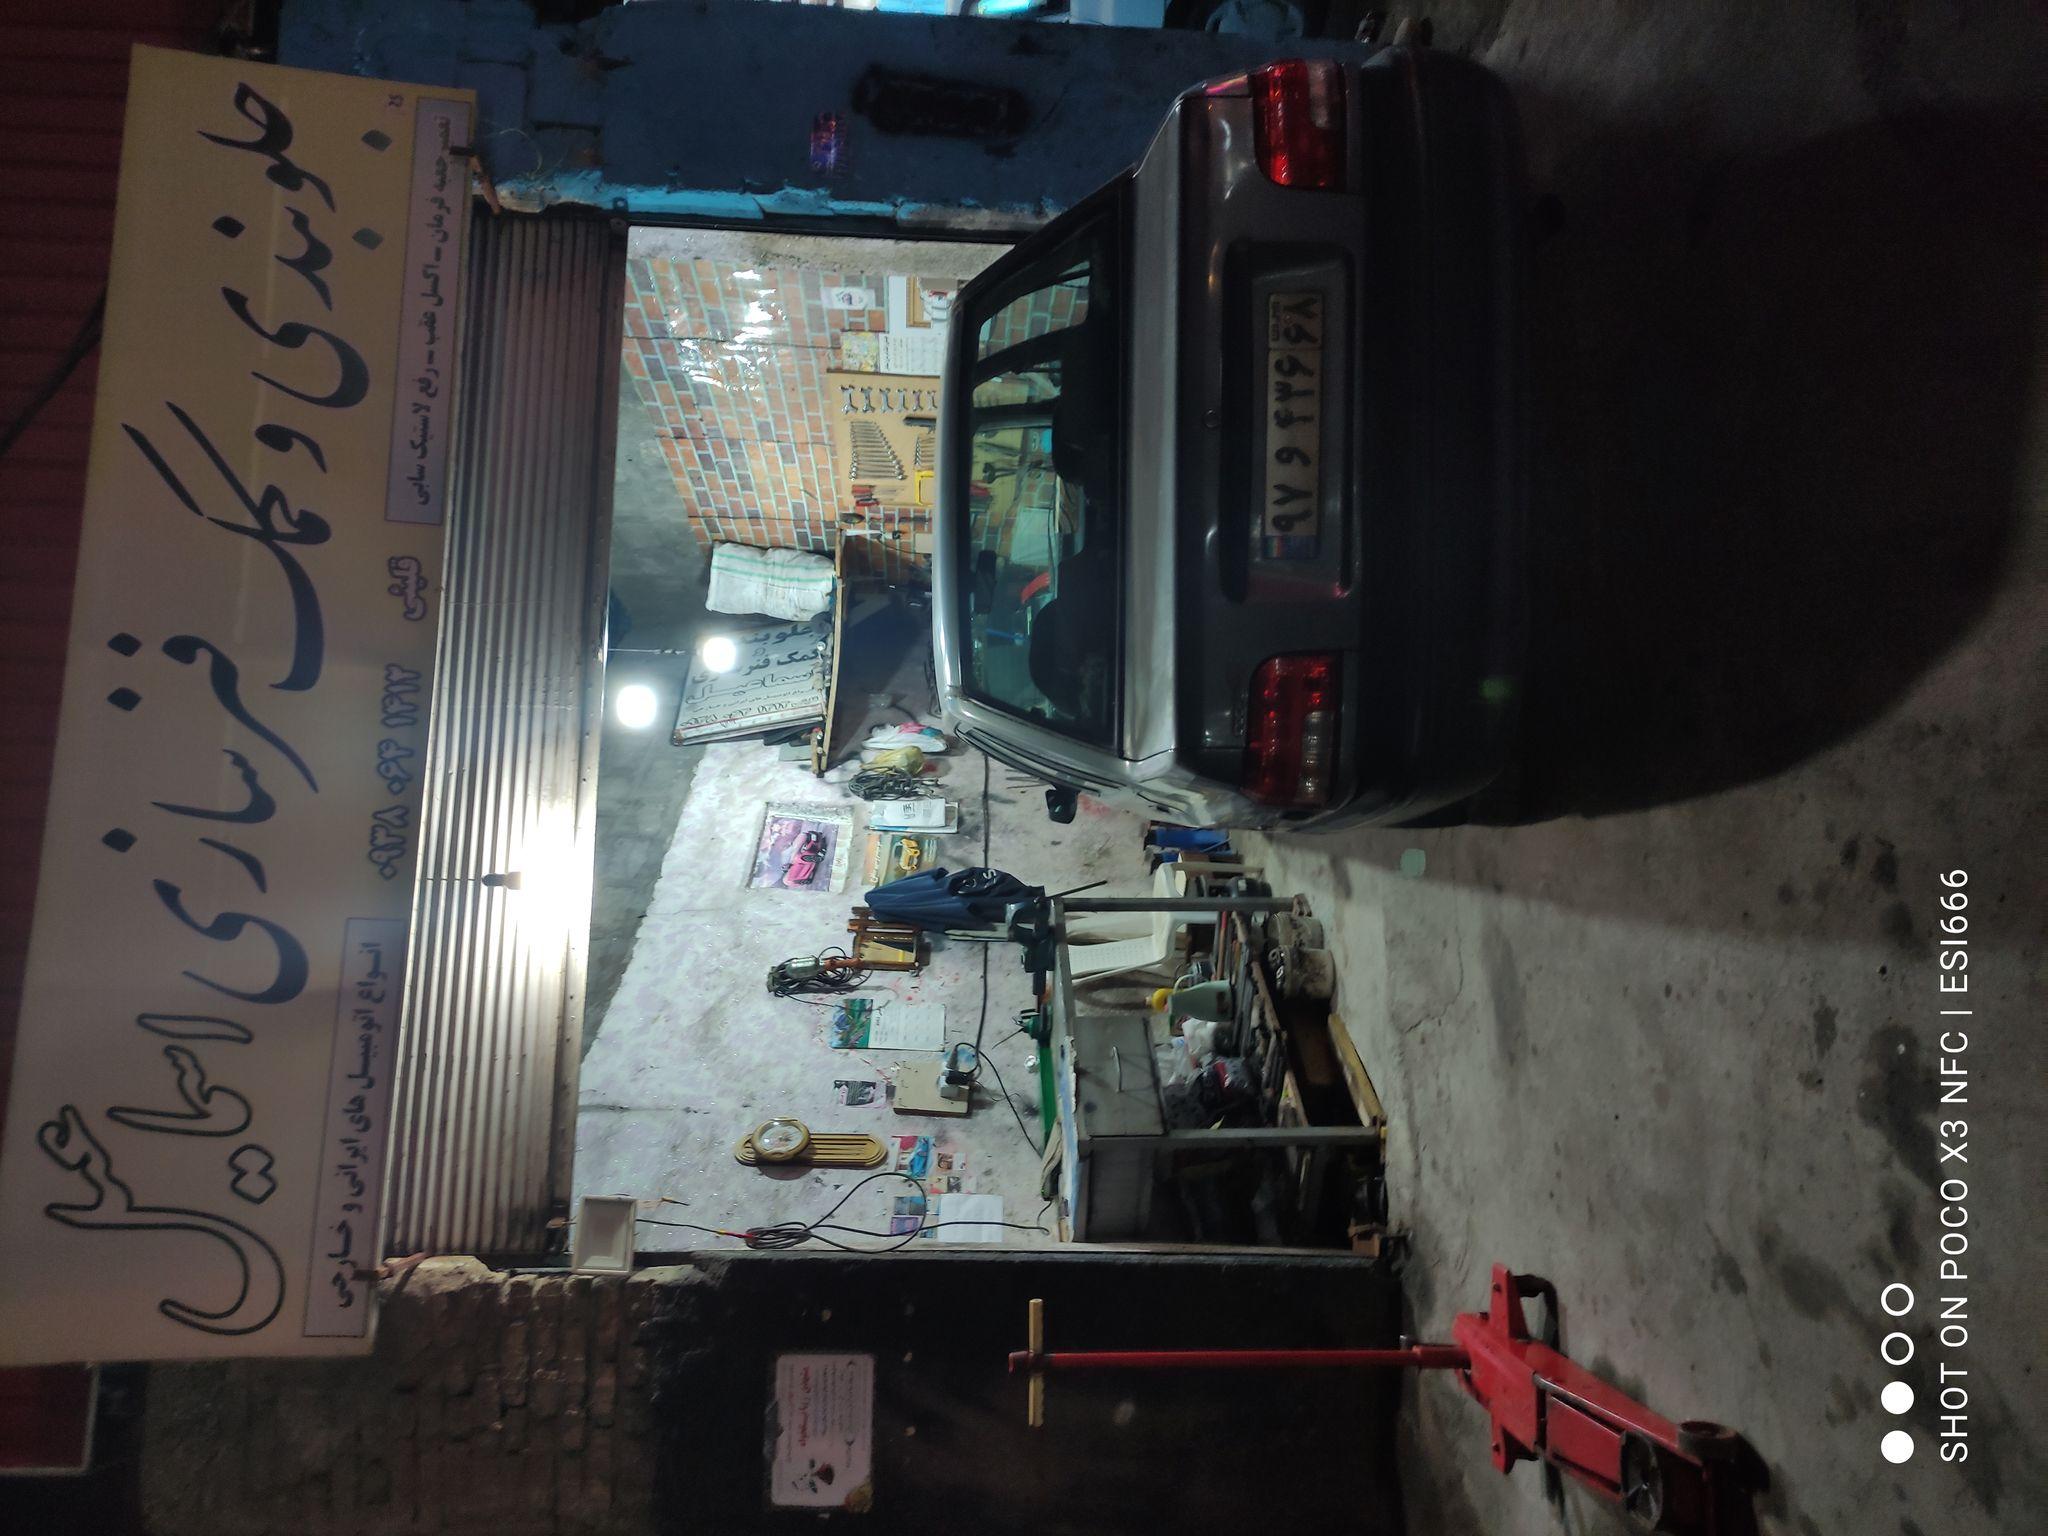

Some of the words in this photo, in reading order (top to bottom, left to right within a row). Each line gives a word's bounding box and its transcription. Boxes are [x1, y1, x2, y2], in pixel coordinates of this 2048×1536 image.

[425, 196, 450, 243] فرمان
[420, 264, 443, 306] اکسل
[417, 311, 439, 345] عقب
[1282, 297, 1319, 345] ۶۸
[412, 368, 438, 398] رفع
[1273, 354, 1315, 429] ۴۳۶
[253, 423, 328, 473] و
[409, 402, 433, 459] لاستیک
[1271, 483, 1313, 532] ۹۷
[368, 804, 409, 880] ۰۹۳۸
[356, 941, 387, 1004] انواع
[345, 1007, 382, 1089] اتومبیل
[342, 1094, 371, 1132] های
[37, 1012, 285, 1335] اسماعیل
[334, 1137, 368, 1197] ایرانی
[341, 1203, 363, 1213] و
